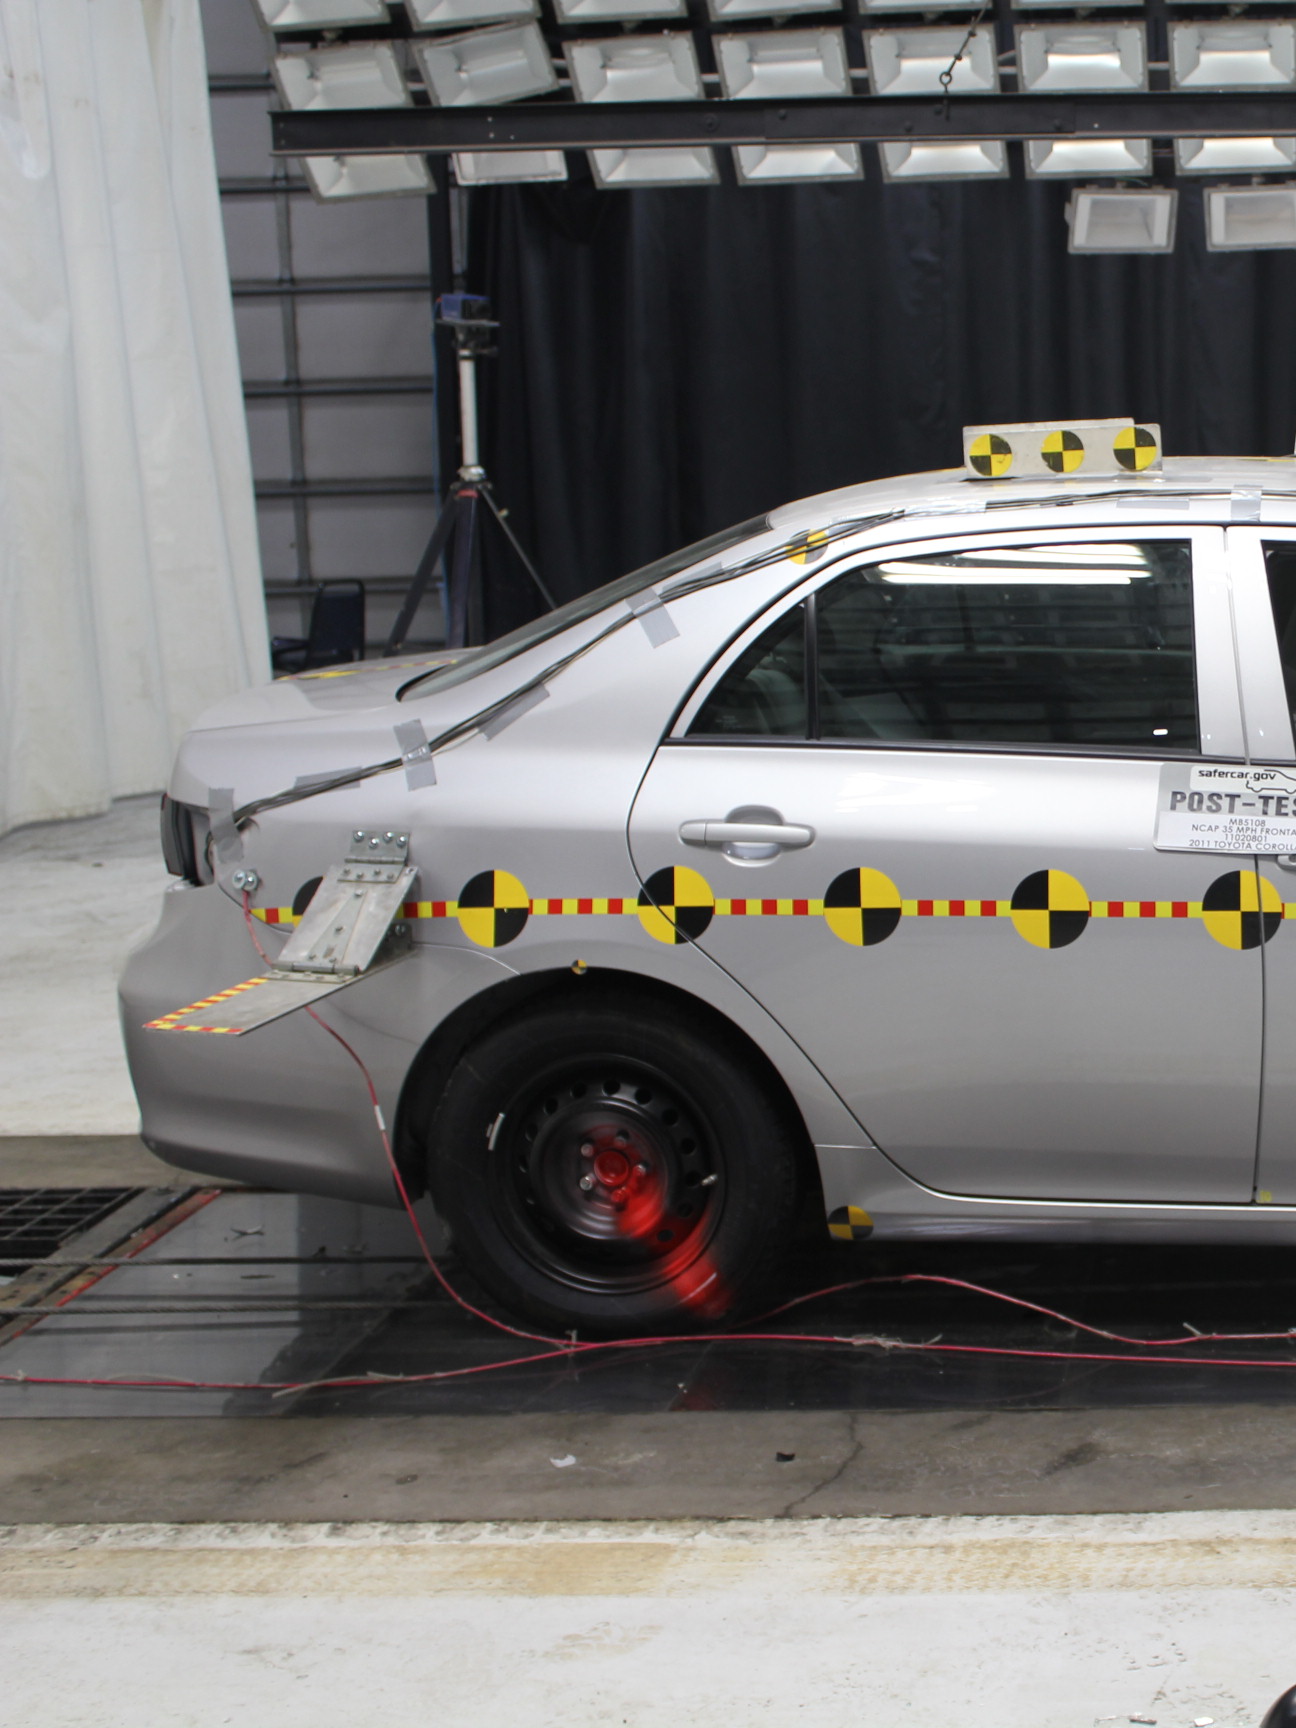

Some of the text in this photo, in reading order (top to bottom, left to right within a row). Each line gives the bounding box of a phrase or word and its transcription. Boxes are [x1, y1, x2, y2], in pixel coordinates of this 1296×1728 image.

[1198, 768, 1277, 781] safercar.gov
[1229, 818, 1266, 827] MB5108
[1191, 824, 1219, 833] NCAP
[1222, 826, 1234, 834] 35
[1236, 827, 1258, 835] MPH
[1224, 834, 1268, 842] 11020801
[1189, 840, 1211, 848] 2011
[1214, 841, 1252, 850] TOYOTA
